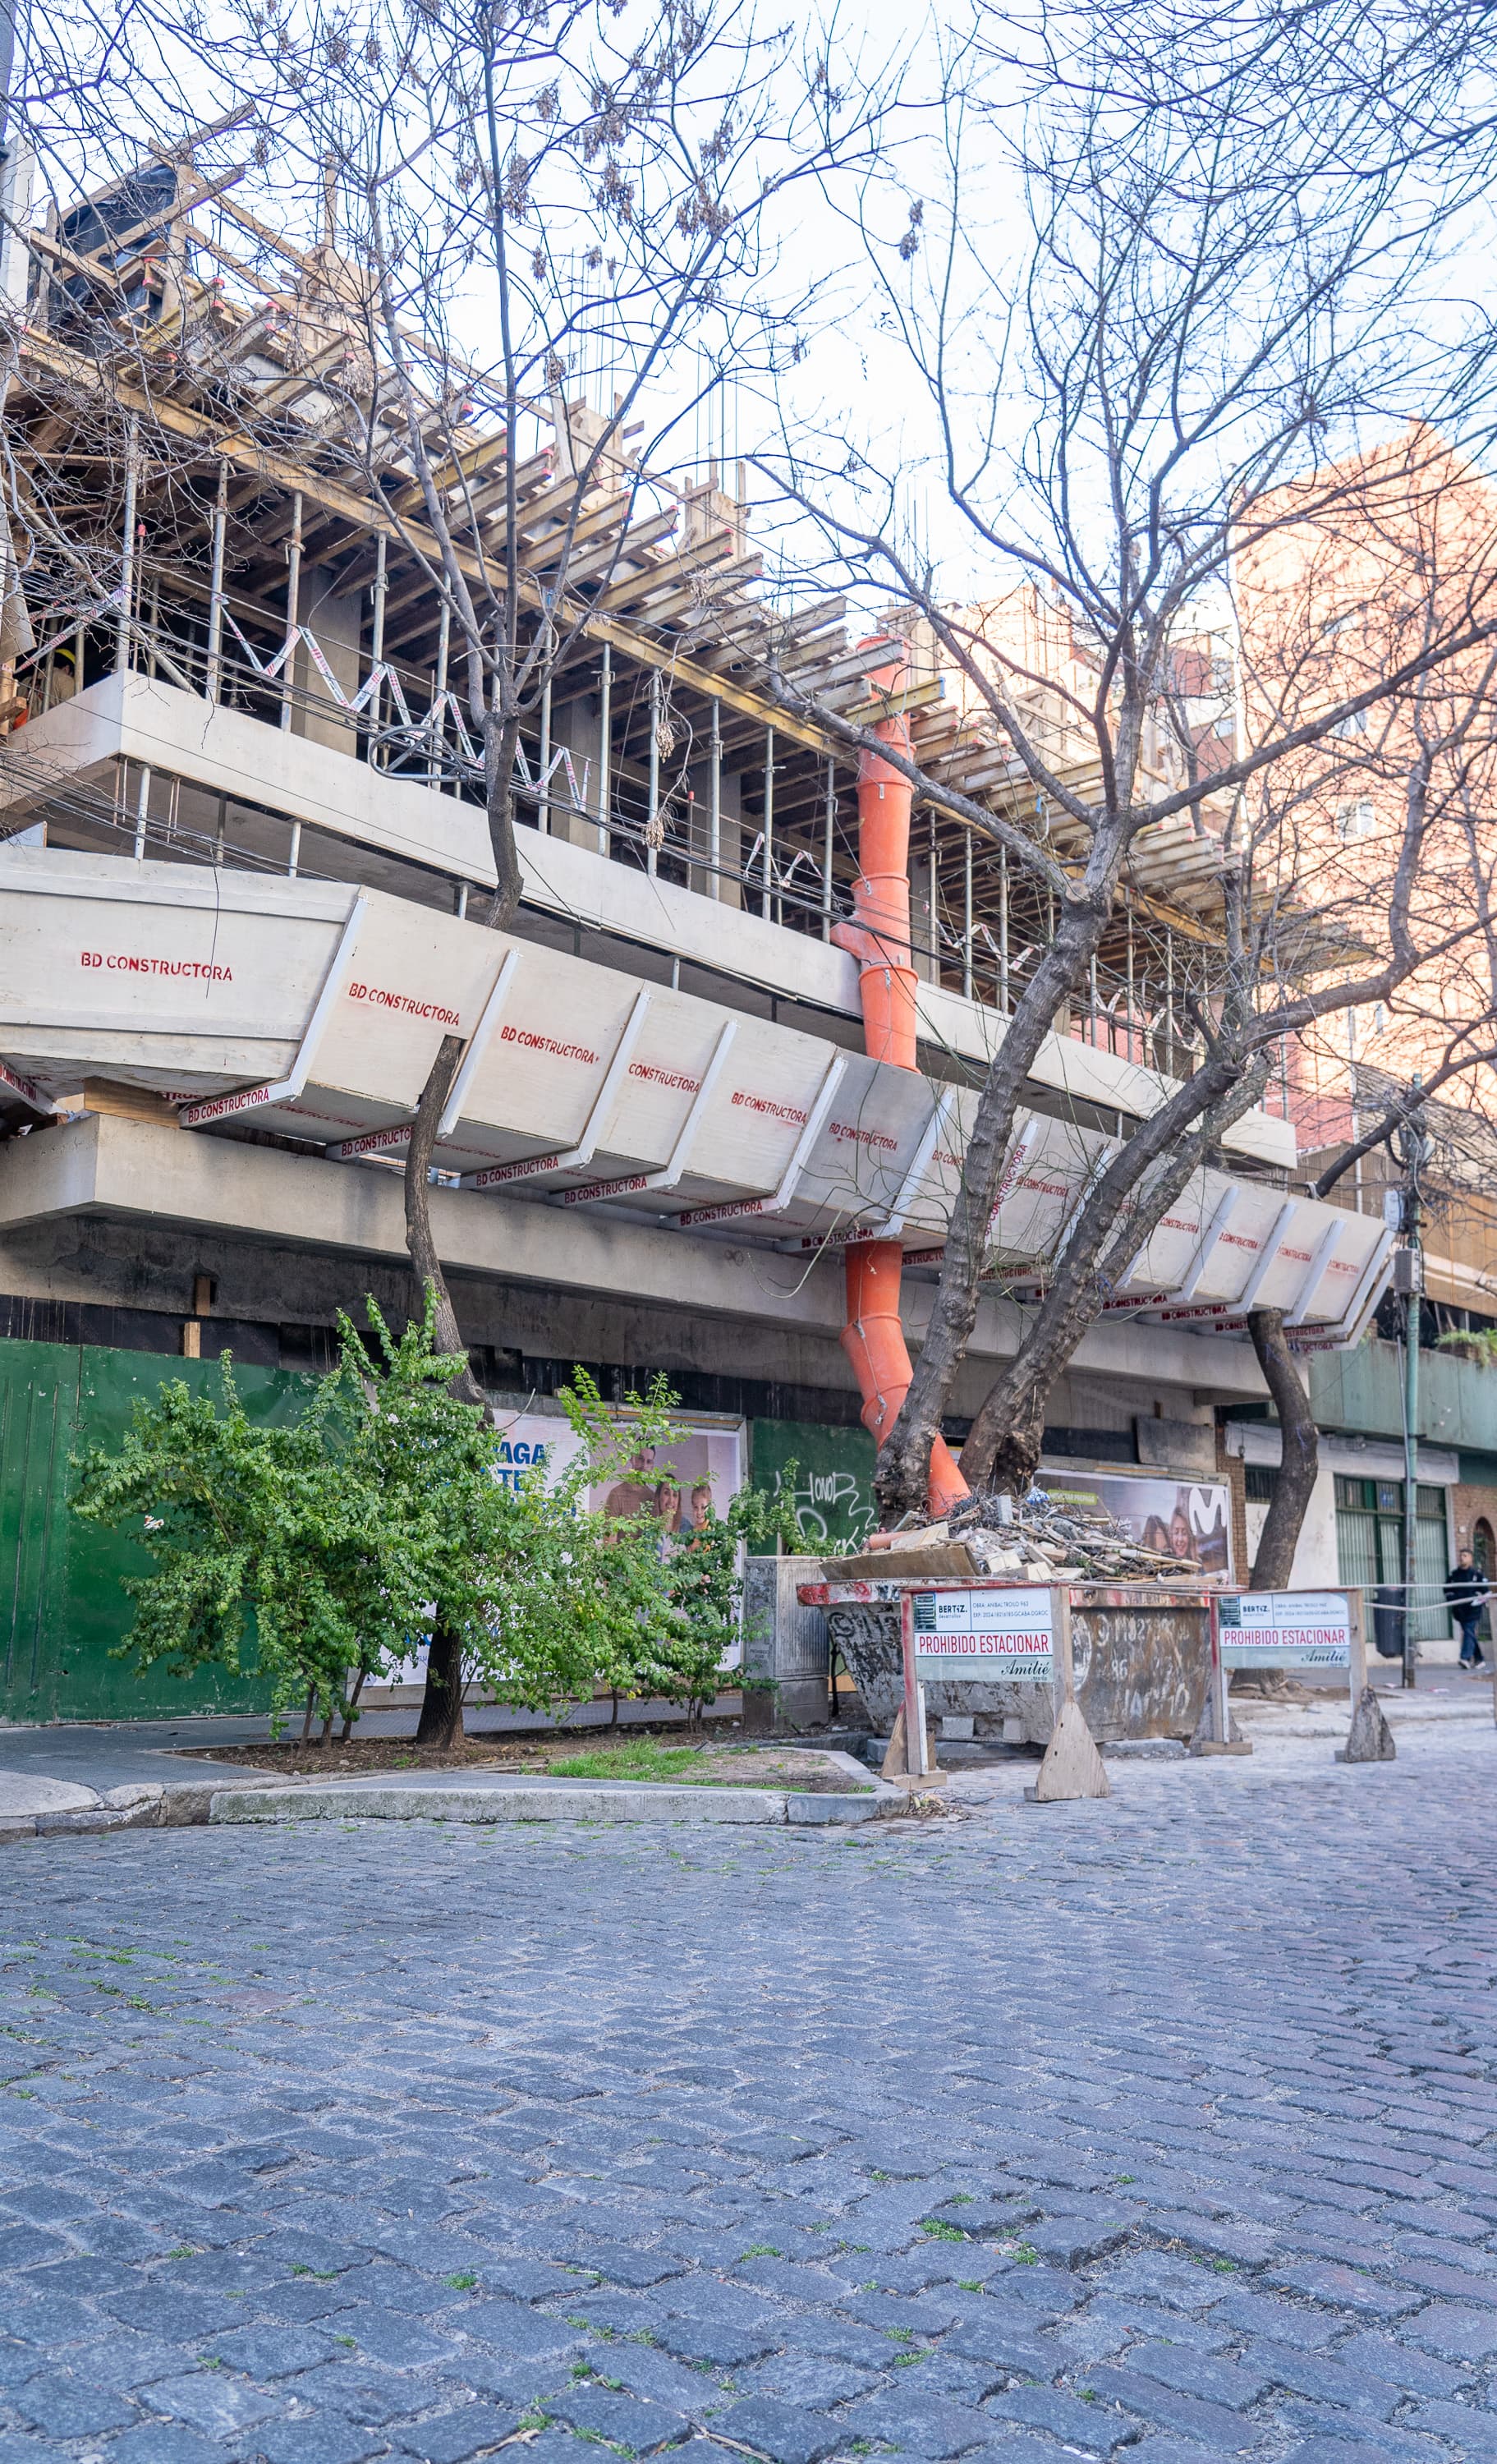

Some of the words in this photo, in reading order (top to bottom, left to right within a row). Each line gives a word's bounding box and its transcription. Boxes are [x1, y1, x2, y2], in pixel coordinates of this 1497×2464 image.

[81, 952, 103, 968] BD
[107, 955, 232, 981] CONSTRUCTORA
[349, 982, 367, 999] BD
[369, 989, 460, 1026] CONSTRUCTORA
[501, 1026, 516, 1041] BD
[517, 1032, 595, 1064] CONSTRUCTORA
[628, 1064, 700, 1093] CONSTRUCTORA
[188, 1109, 200, 1124] BD
[201, 1087, 269, 1119] CONSTRUCTORA
[731, 1092, 744, 1105] BD
[744, 1096, 806, 1124] CONSTRUCTORA
[342, 1142, 353, 1156] BD
[354, 1126, 414, 1152] CONSTRUCTO
[829, 1123, 841, 1134] BD
[476, 1174, 488, 1187] BD
[489, 1156, 559, 1183] CONSTRUCTORA
[564, 1190, 576, 1204] BD
[577, 1175, 647, 1201] CONSTRUCTORA
[680, 1213, 691, 1227] BD
[694, 1200, 763, 1225] CONSTRUCTORA
[920, 1635, 976, 1653] PROHIBIDO
[980, 1634, 1049, 1653] ESTACIONAR
[1224, 1630, 1279, 1645] PROHIBIDO
[1283, 1629, 1345, 1644] ESTACIONAR
